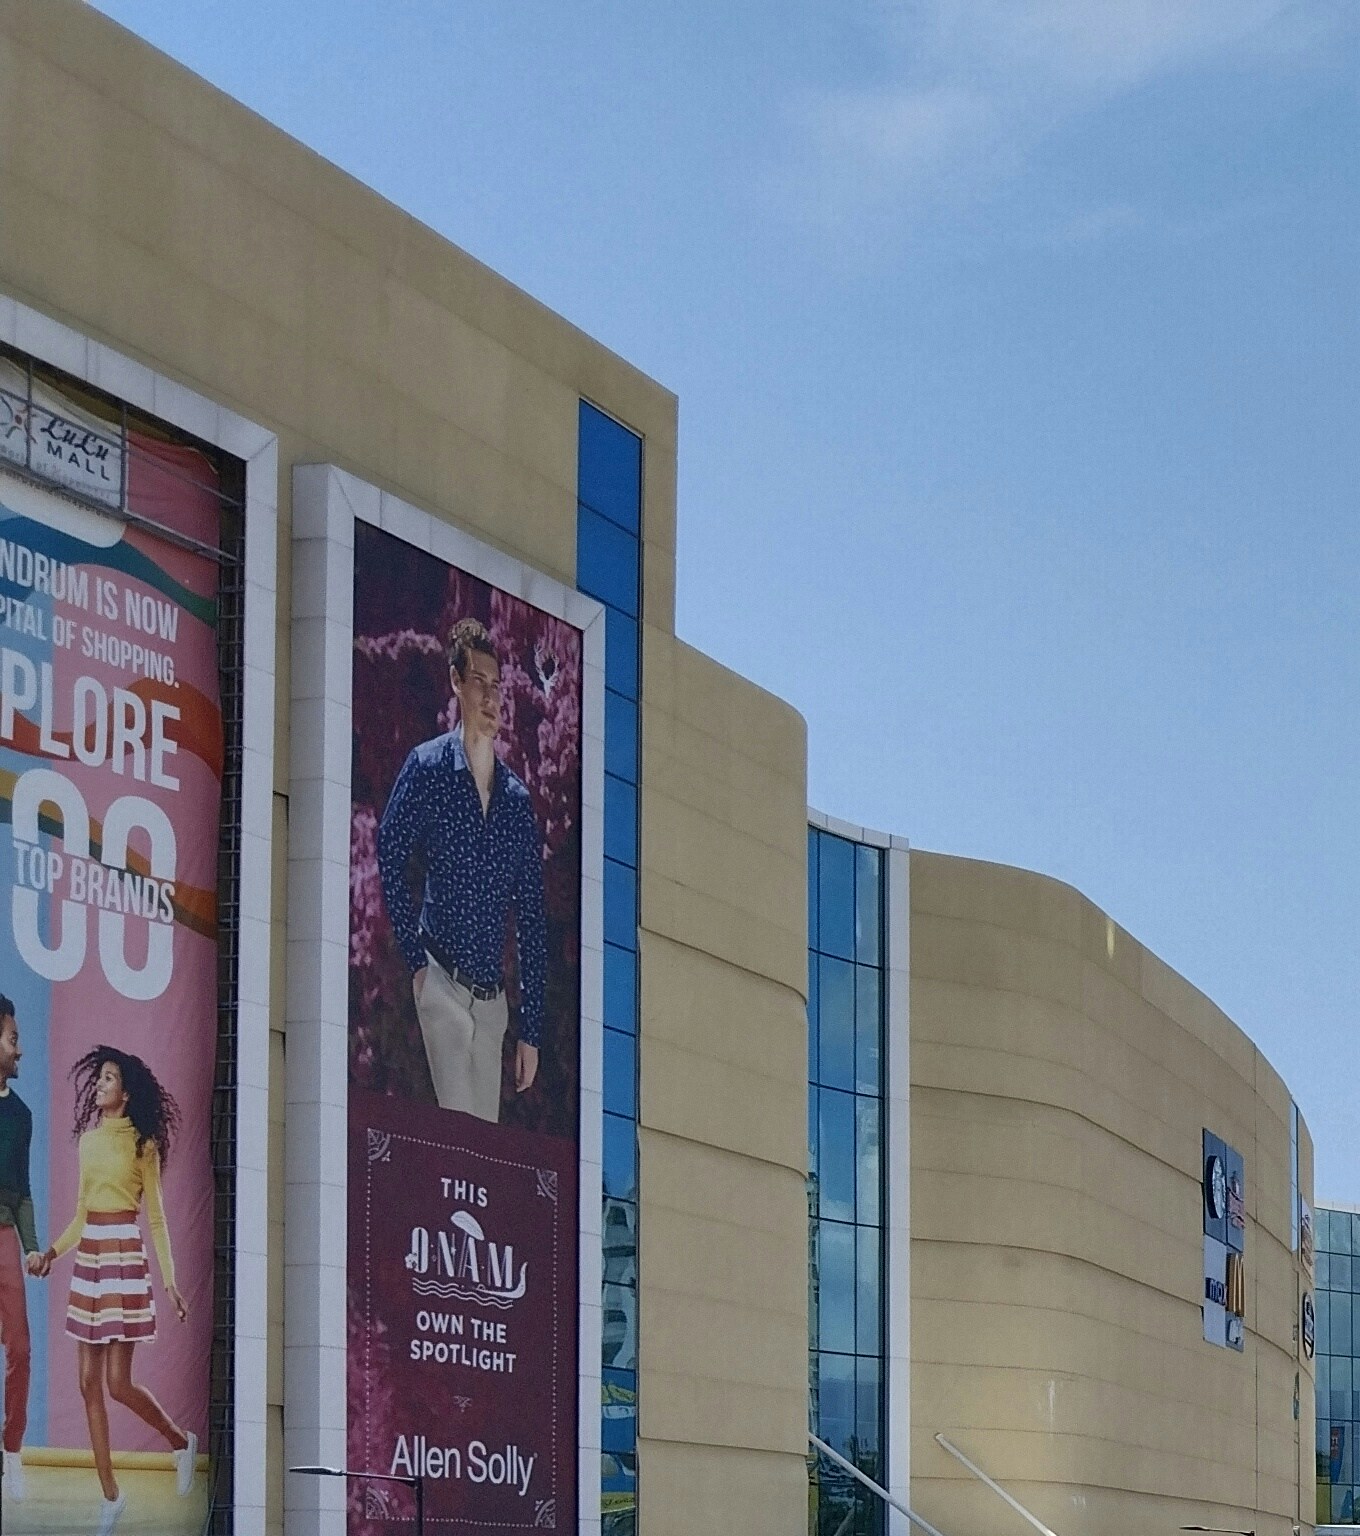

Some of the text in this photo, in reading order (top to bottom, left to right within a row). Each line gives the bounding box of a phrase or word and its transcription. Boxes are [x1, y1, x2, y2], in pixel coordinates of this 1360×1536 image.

[47, 440, 110, 481] MALL
[96, 577, 118, 621] IS
[125, 588, 178, 643] NOW
[52, 614, 78, 650] OF
[81, 625, 180, 689] SHOPPING.
[0, 646, 181, 792] PLORE
[17, 841, 175, 924] TOP BRANDS
[440, 1176, 488, 1208] THIS
[410, 1339, 517, 1373] SPOTLIGHT
[416, 1310, 508, 1344] OWN THE
[390, 1435, 536, 1497] Allen Solly
